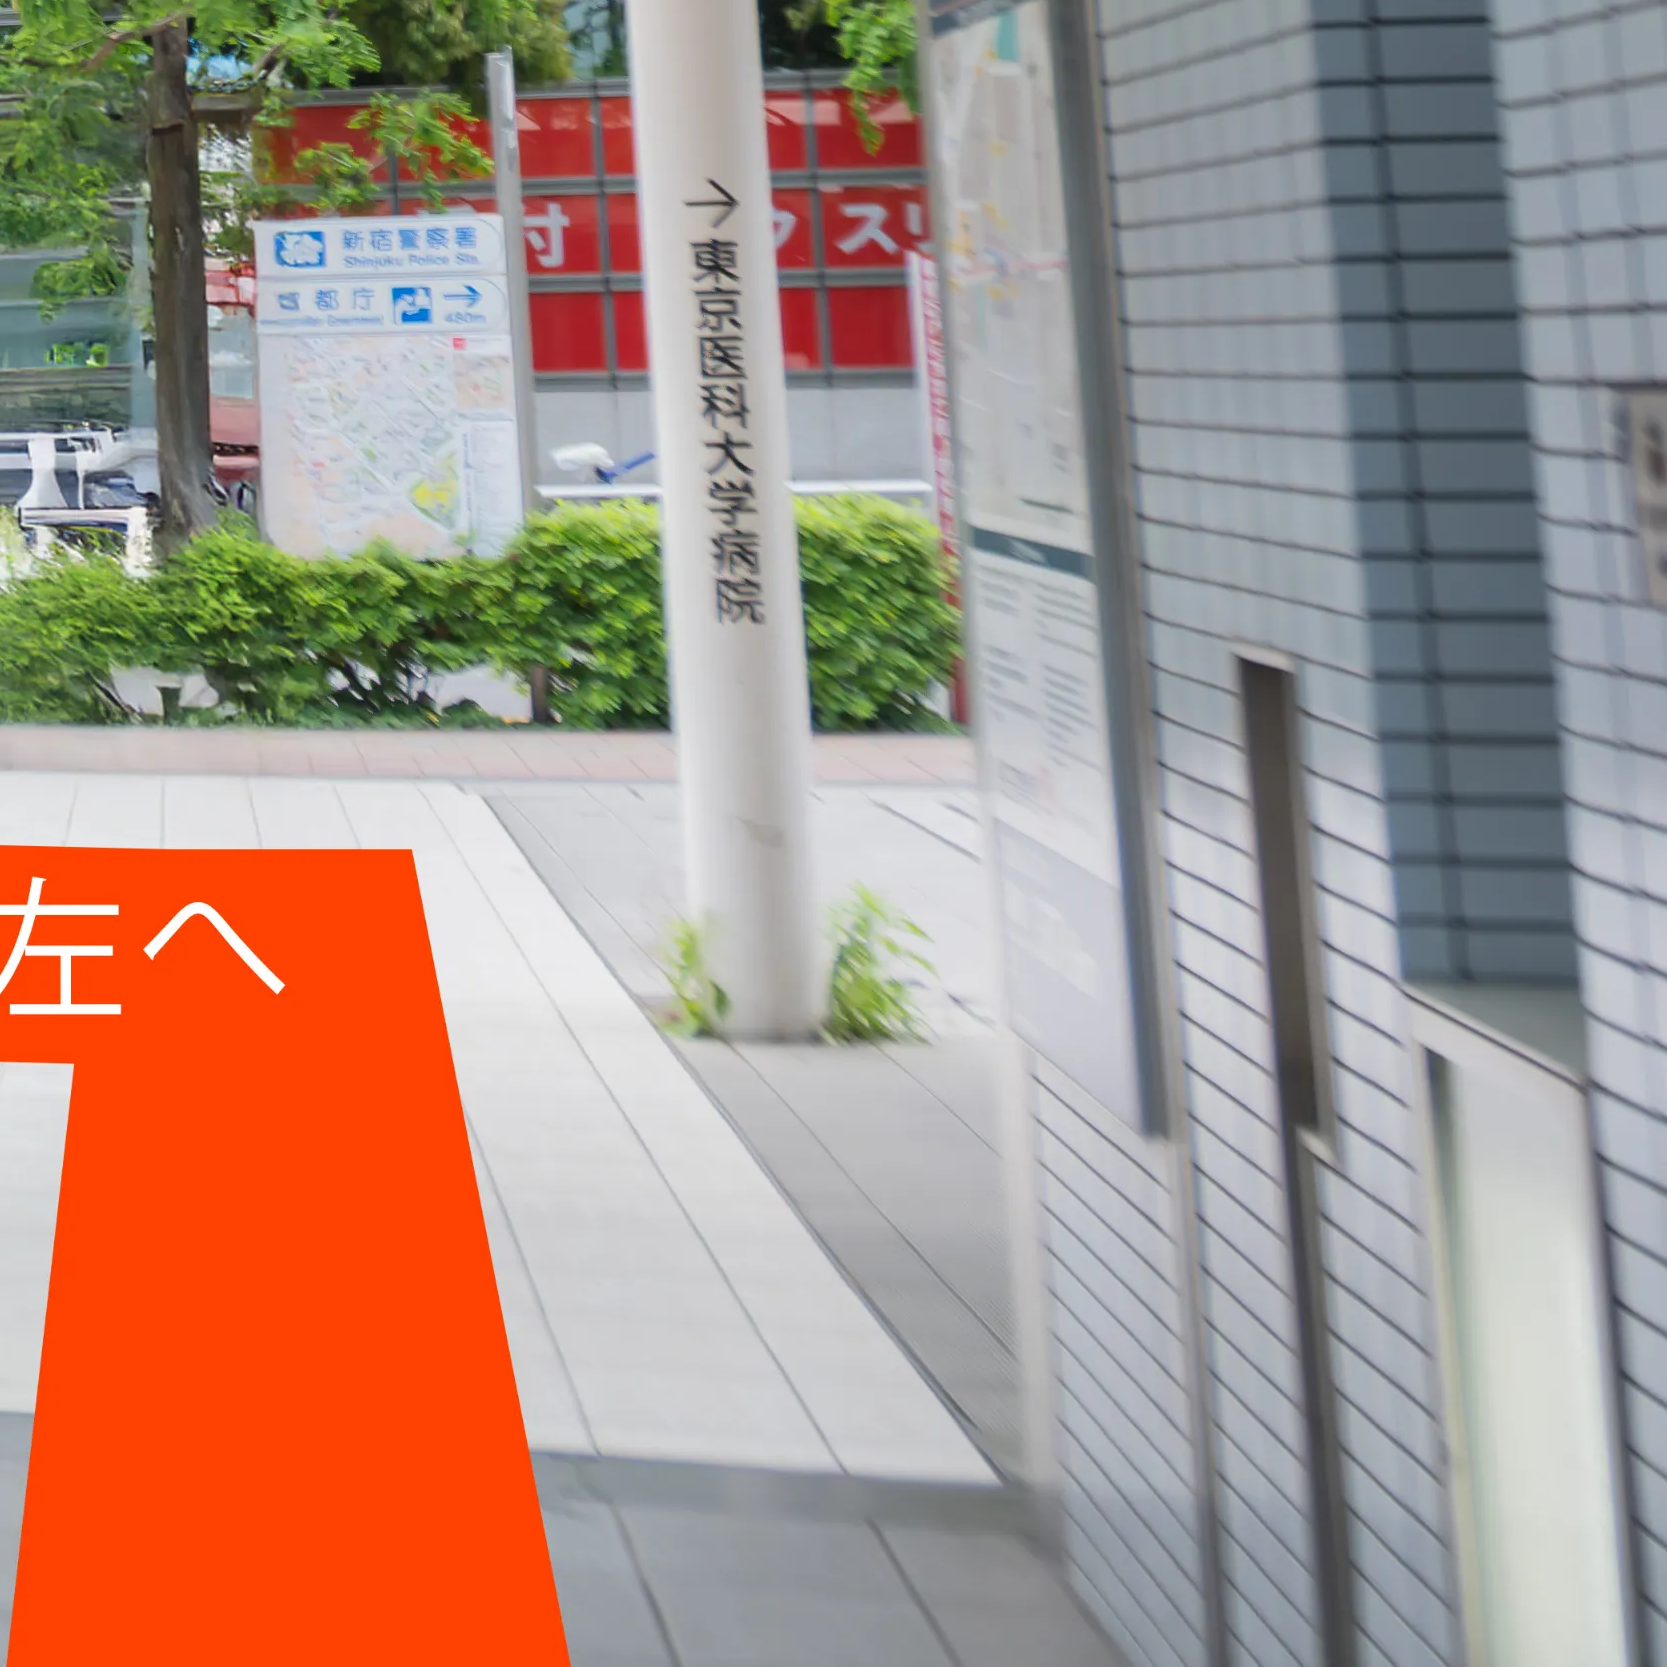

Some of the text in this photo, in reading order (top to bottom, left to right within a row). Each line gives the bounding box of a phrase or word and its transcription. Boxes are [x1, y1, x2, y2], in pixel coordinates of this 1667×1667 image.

[688, 238, 765, 626] 東京医科大学病院
